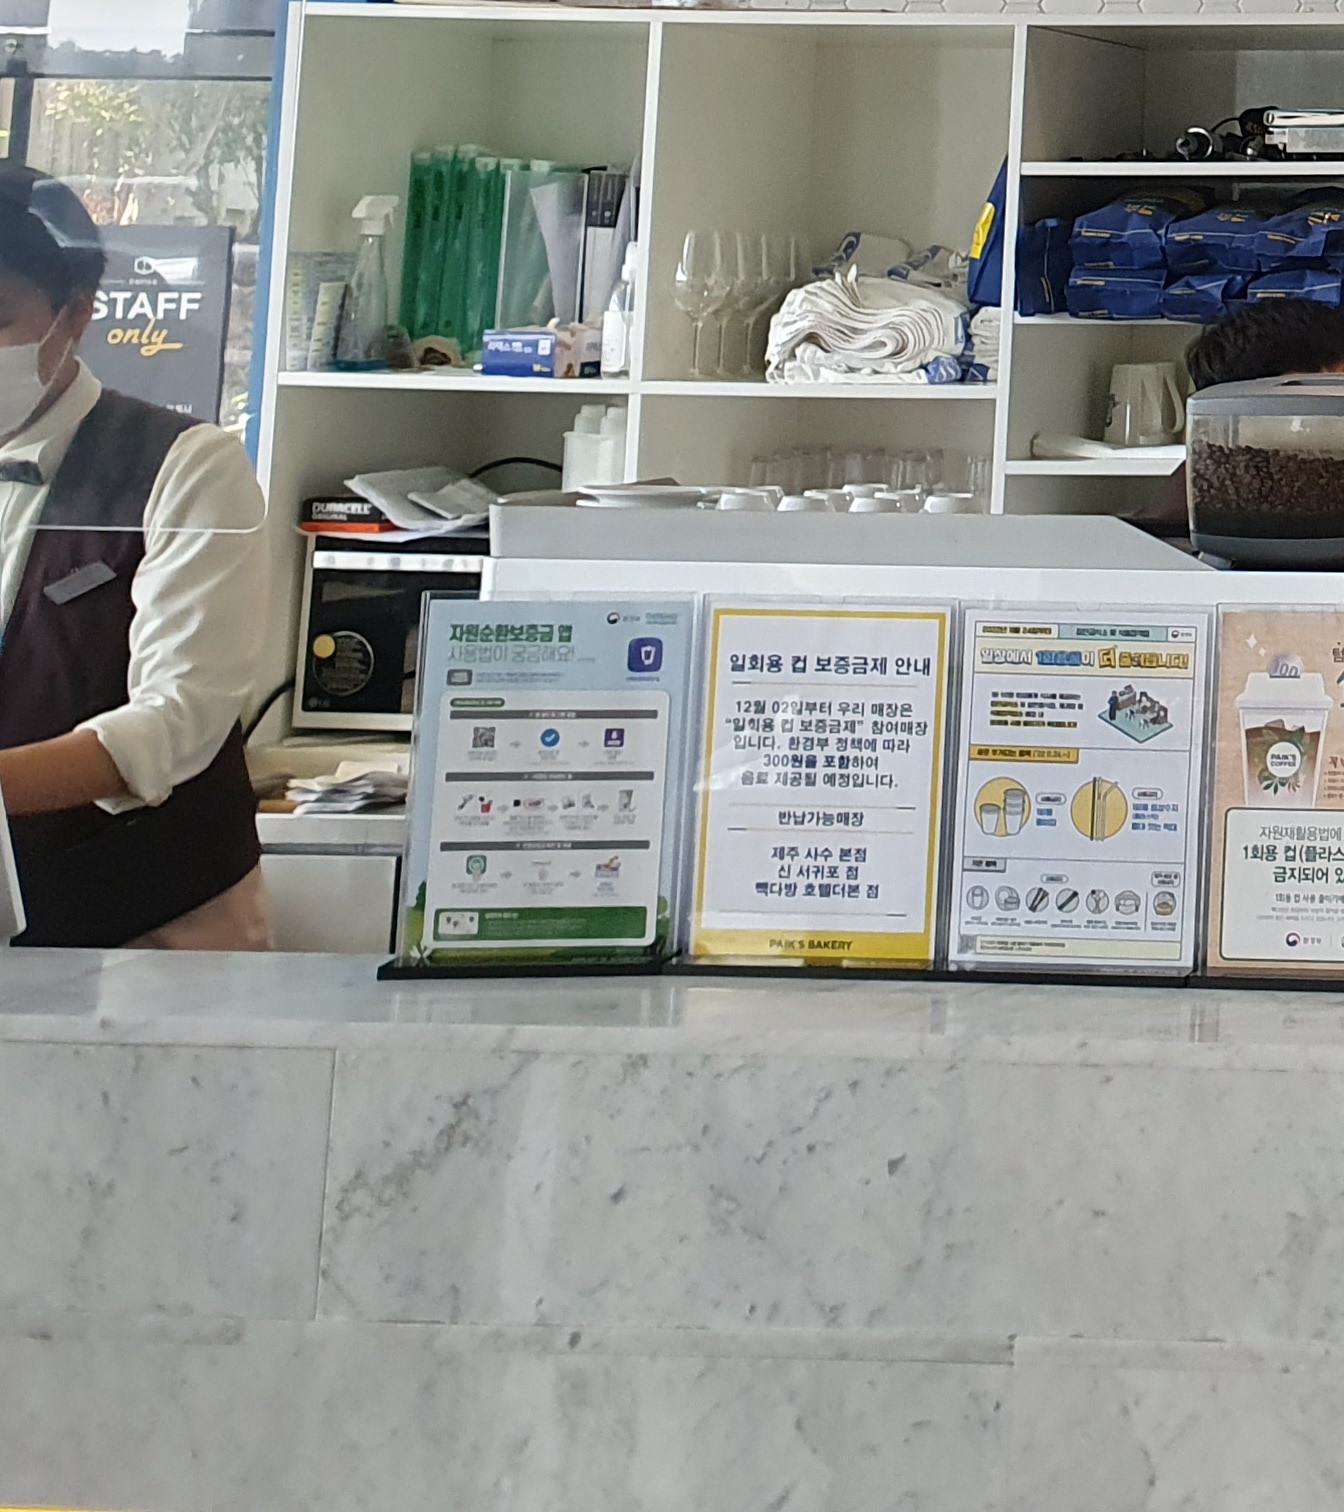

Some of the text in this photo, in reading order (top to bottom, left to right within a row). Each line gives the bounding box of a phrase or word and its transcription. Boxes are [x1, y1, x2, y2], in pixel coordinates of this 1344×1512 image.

[91, 290, 202, 320] STAFF
[107, 317, 183, 356] only
[730, 654, 931, 676] 일회용 컵 보증금제 안내
[736, 700, 913, 717] 12월 02일부터 우리 매장은
[779, 811, 864, 826] 반납가능매장
[1273, 866, 1329, 884] 금지되어
[769, 939, 853, 950] PAIK'S BAKERY
